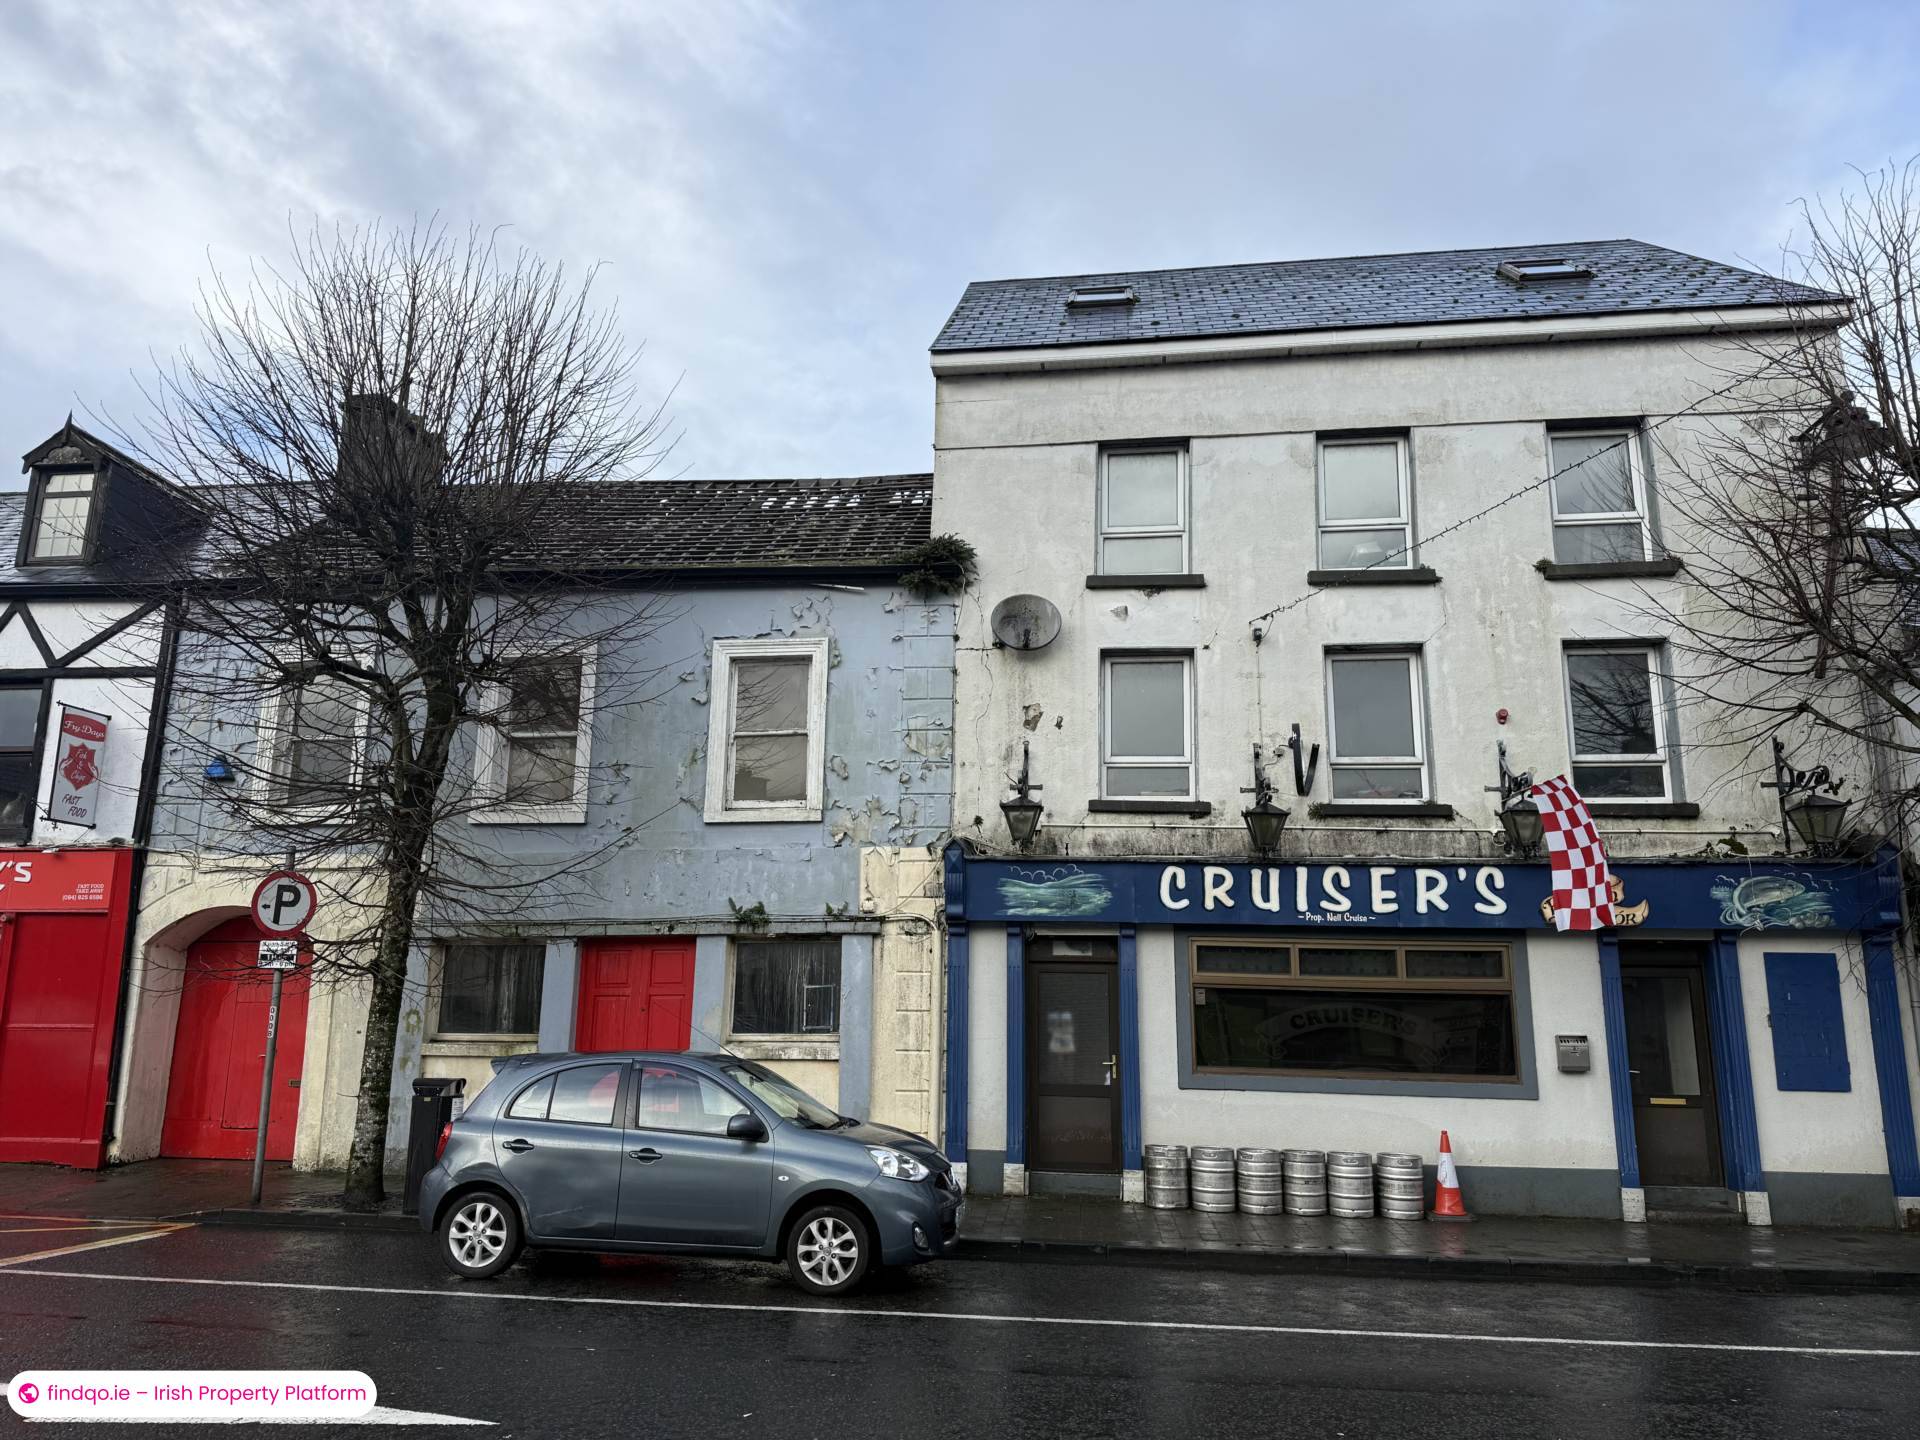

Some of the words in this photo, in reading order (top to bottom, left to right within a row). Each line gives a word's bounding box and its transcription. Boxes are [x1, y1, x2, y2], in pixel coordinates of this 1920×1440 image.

[62, 794, 84, 805] FAST
[68, 806, 88, 818] FOOD
[1160, 865, 1508, 914] CRUISER'S
[272, 884, 302, 925] P
[1305, 912, 1324, 923] Prop.
[1344, 912, 1367, 922] Cruise
[1615, 910, 1636, 925] ÓR
[1290, 1007, 1417, 1034] CRUISER'S
